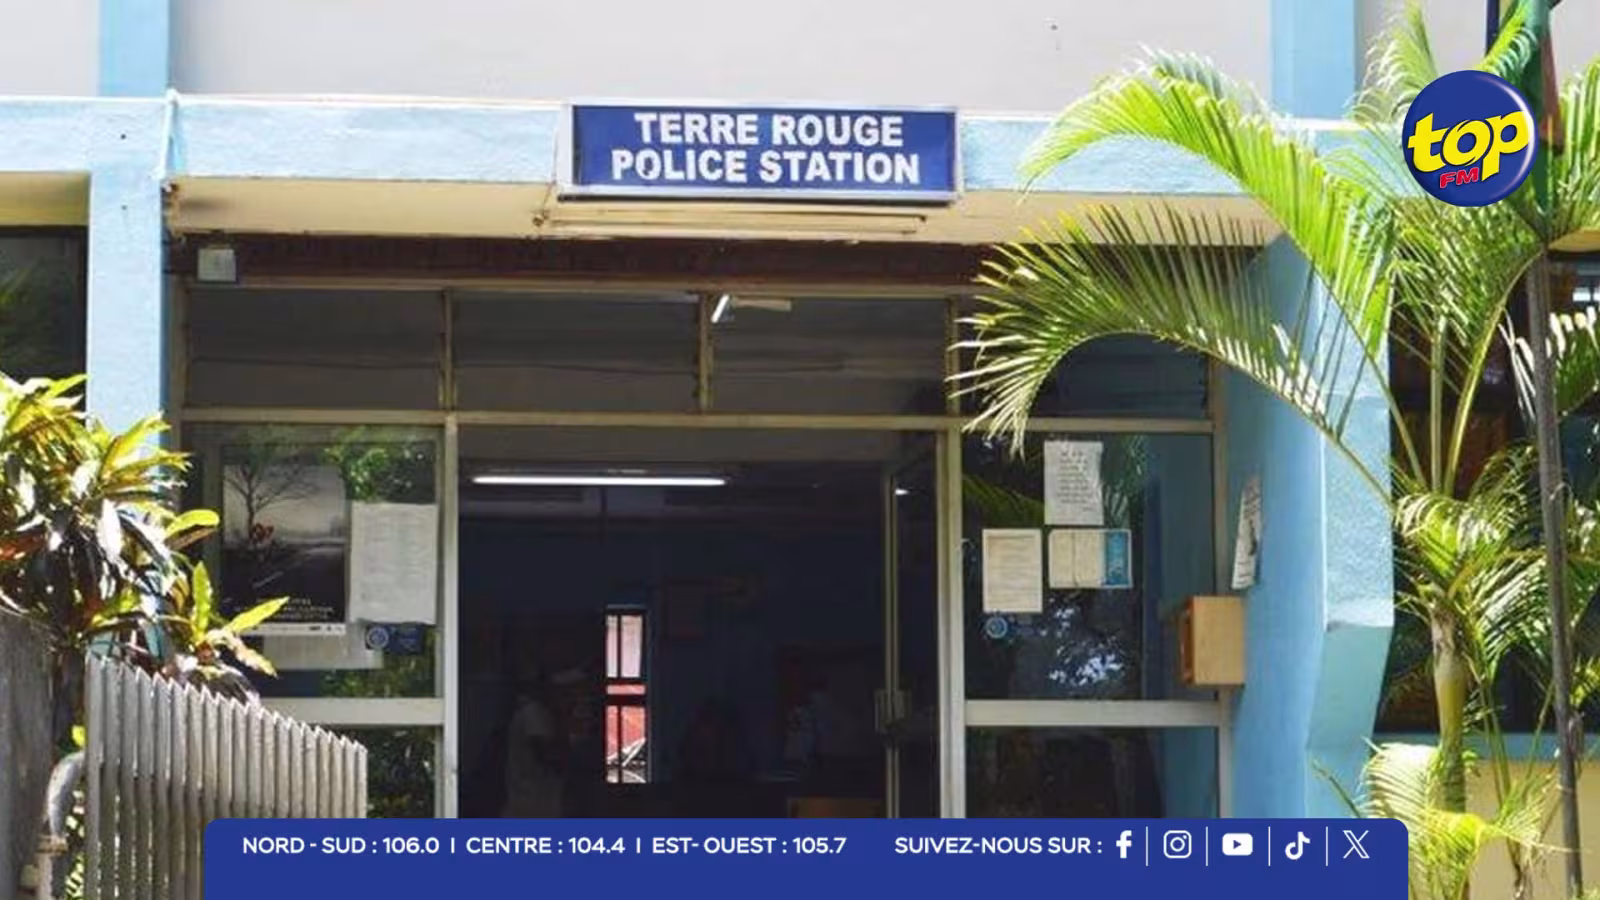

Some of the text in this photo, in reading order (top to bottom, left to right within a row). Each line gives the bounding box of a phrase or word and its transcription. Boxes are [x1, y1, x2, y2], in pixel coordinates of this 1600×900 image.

[634, 112, 904, 147] TERRE ROUGE
[611, 149, 921, 184] POLICE STATION
